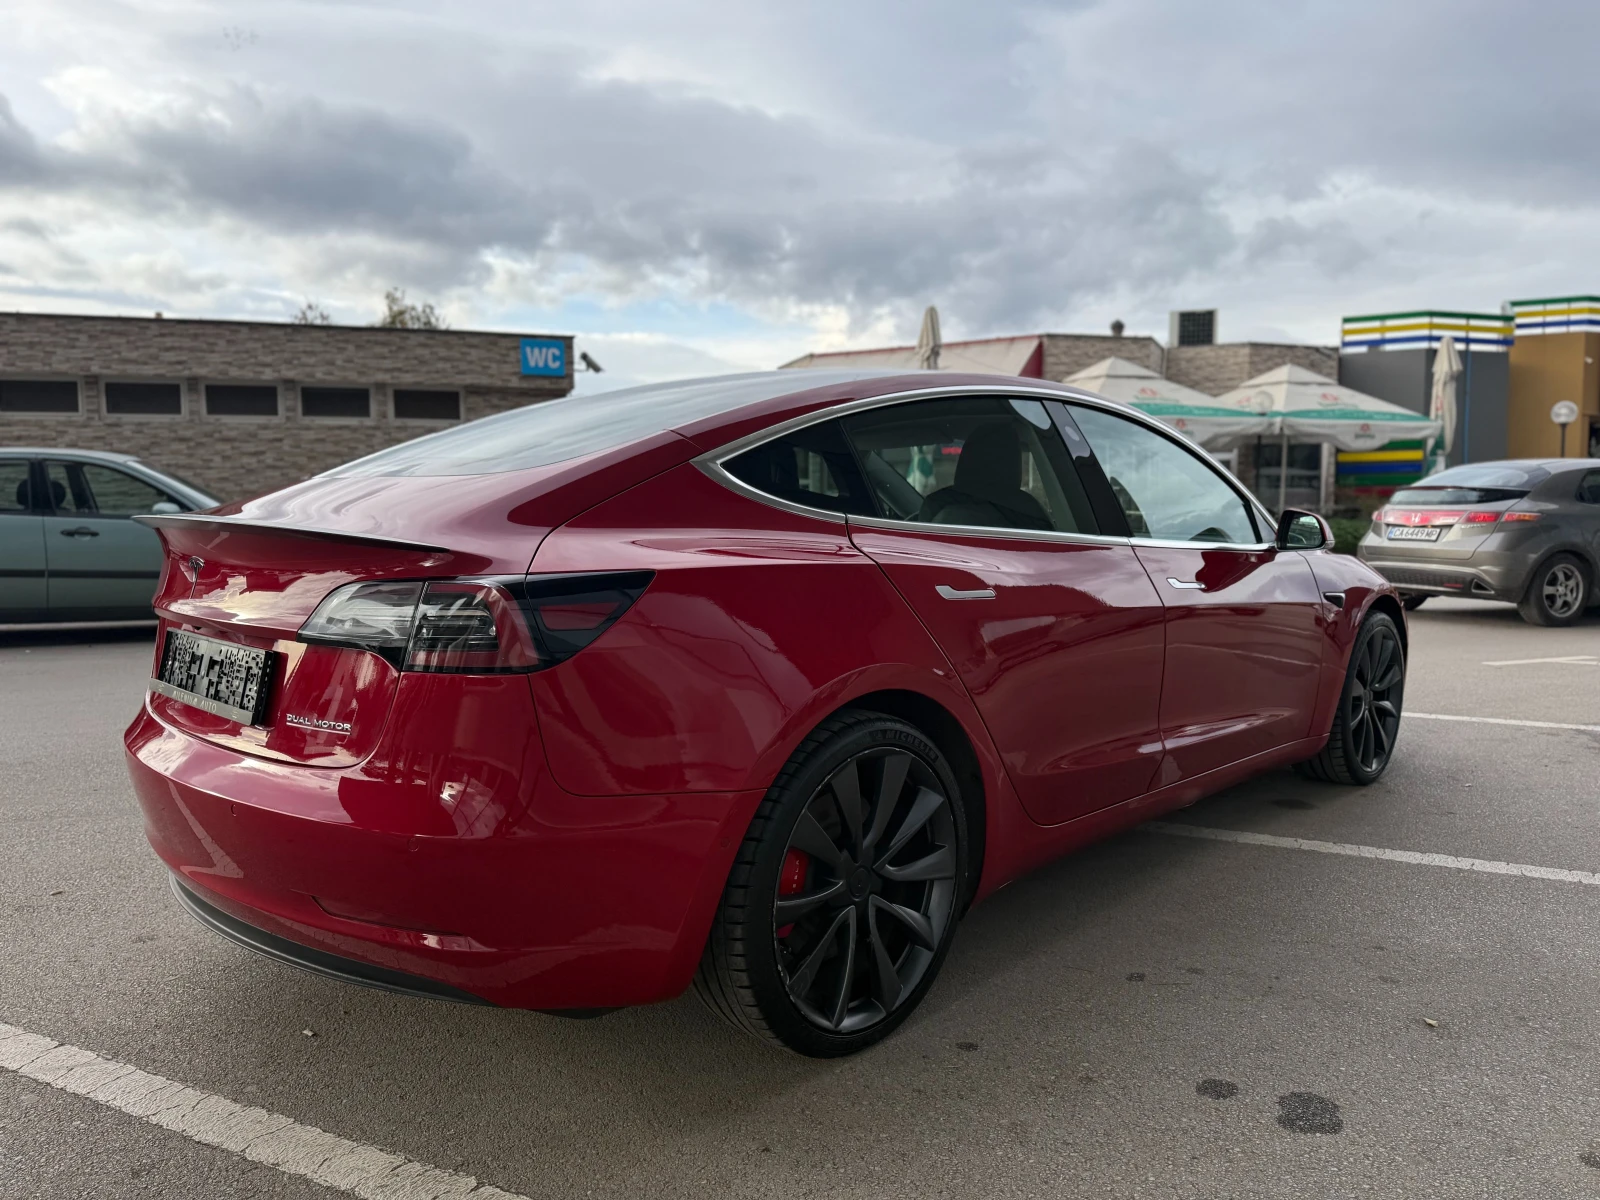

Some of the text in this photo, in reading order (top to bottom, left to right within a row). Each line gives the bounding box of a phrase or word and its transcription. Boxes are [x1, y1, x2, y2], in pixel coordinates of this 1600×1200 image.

[525, 346, 561, 369] WC
[1393, 528, 1438, 538] CA 6449 MP
[200, 699, 217, 713] AUTO
[286, 713, 352, 731] DUAL MOTOR
[885, 729, 938, 761] MICHELIN
